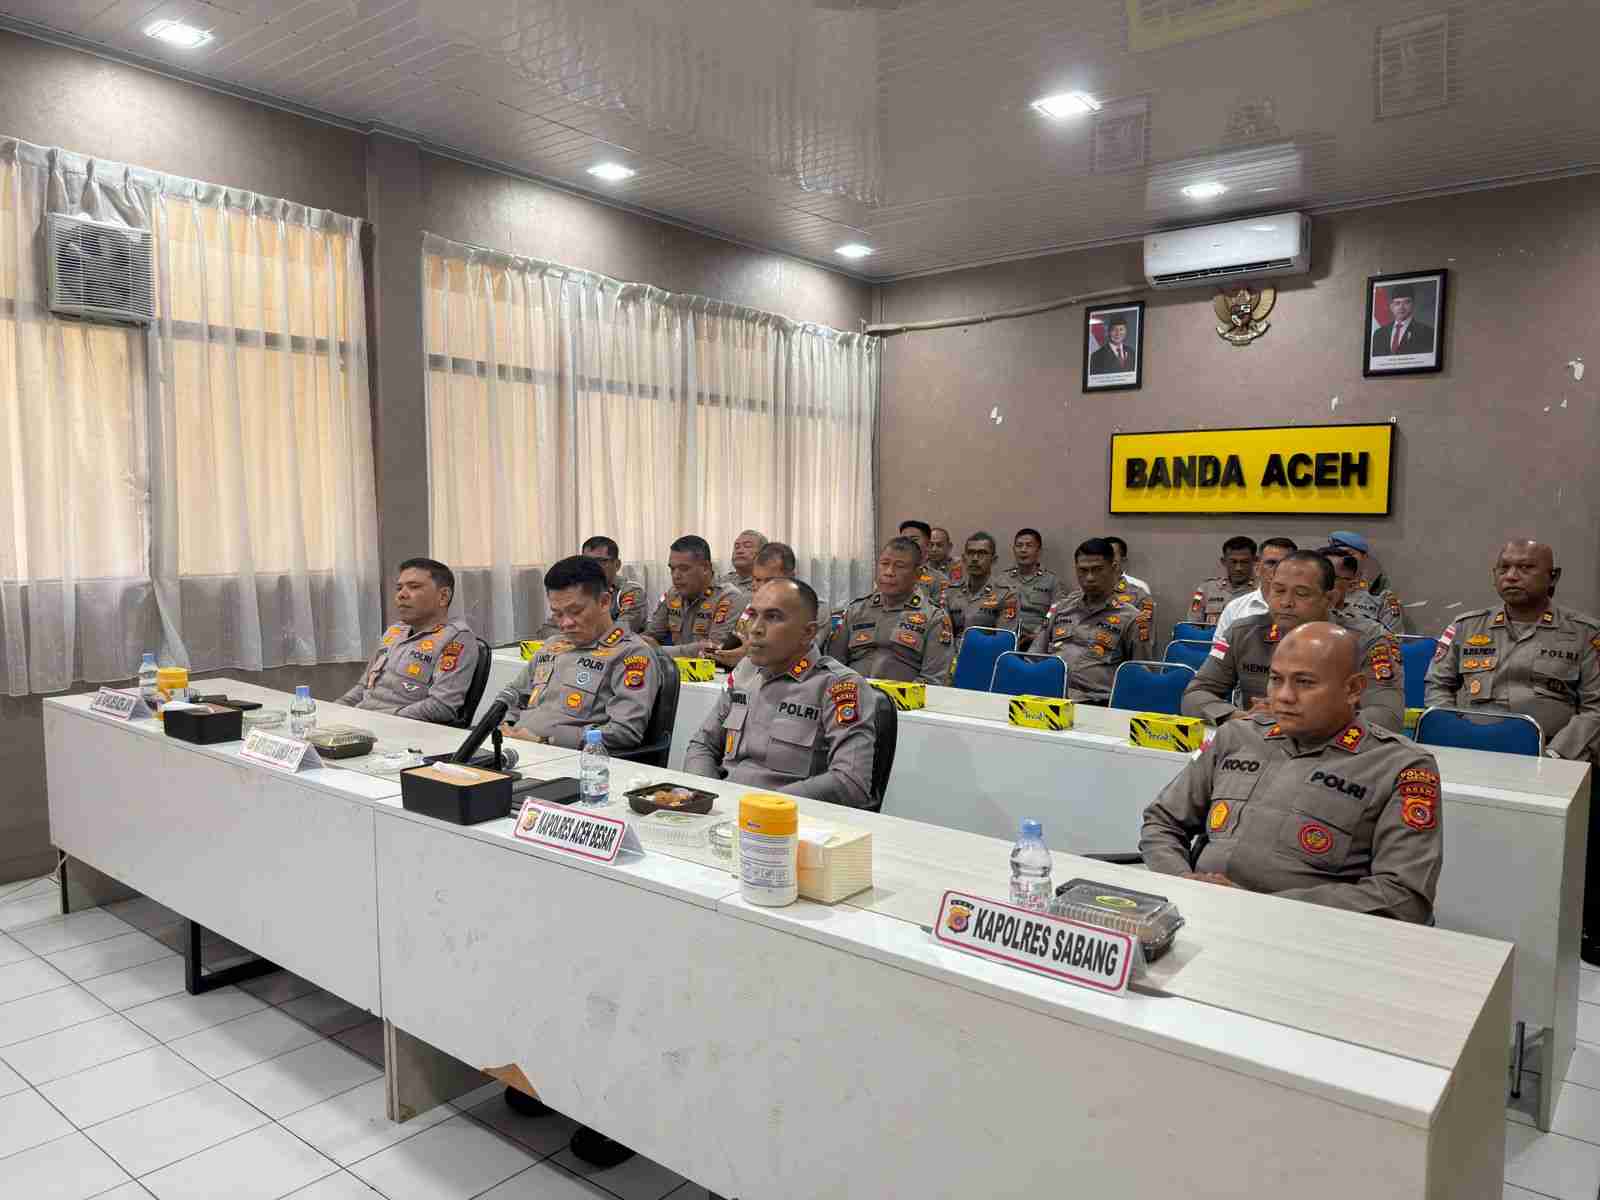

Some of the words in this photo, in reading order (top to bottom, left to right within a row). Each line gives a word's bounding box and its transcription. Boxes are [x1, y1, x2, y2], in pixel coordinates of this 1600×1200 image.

[1126, 455, 1246, 488] BANDA
[1261, 452, 1369, 487] ACEH
[900, 622, 926, 634] POLRI
[577, 657, 604, 671] POLRI
[1540, 649, 1579, 661] POLRI
[778, 702, 819, 720] POLRI
[1222, 758, 1260, 773] KOCO
[1311, 771, 1366, 800] POLRI
[536, 811, 575, 841] KAPOLRES
[569, 820, 594, 846] ACEH
[589, 823, 618, 852] BESAR
[973, 907, 1051, 957] KAPOLRES
[1052, 929, 1119, 977] SABANG
